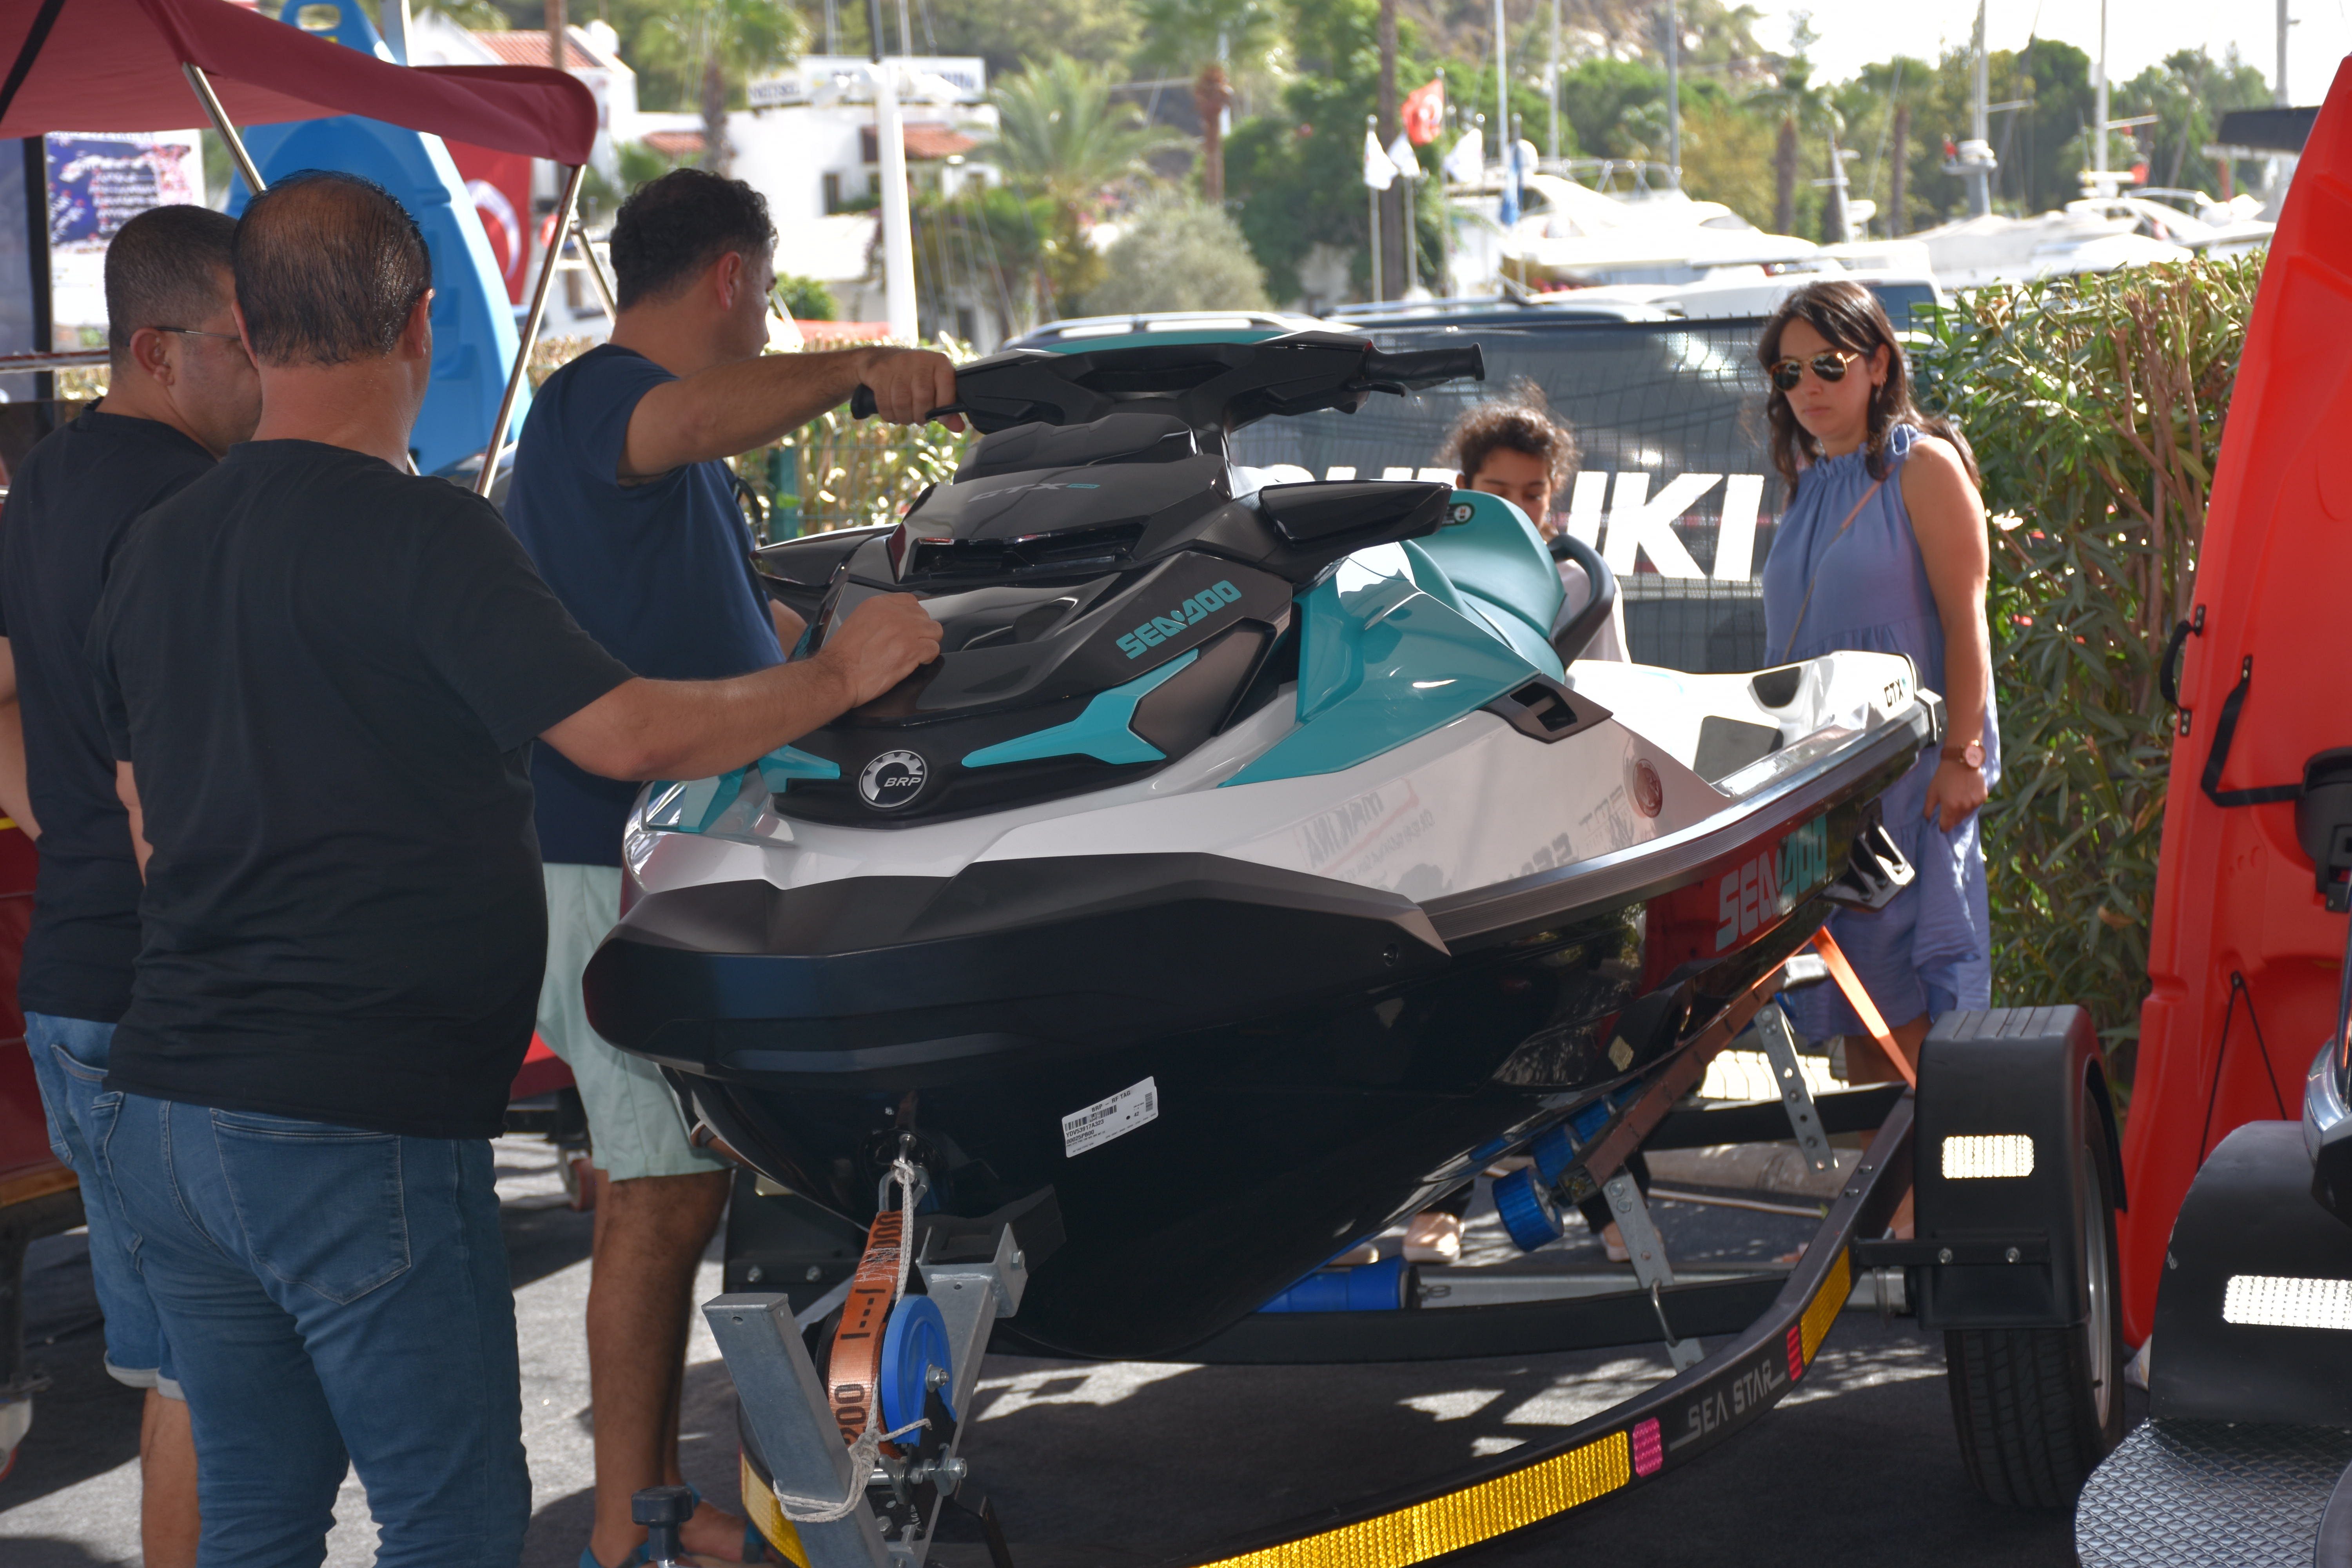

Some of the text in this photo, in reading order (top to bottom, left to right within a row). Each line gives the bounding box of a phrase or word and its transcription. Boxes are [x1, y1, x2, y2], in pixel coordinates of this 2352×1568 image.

[967, 483, 1069, 503] GTX
[1884, 679, 1904, 708] GTX
[884, 777, 922, 787] BRP
[1091, 1103, 1103, 1112] BRP
[1120, 1090, 1131, 1099] TAG
[1066, 1119, 1104, 1138] YDV53917A323
[1679, 1359, 1778, 1443] SEA STAR
